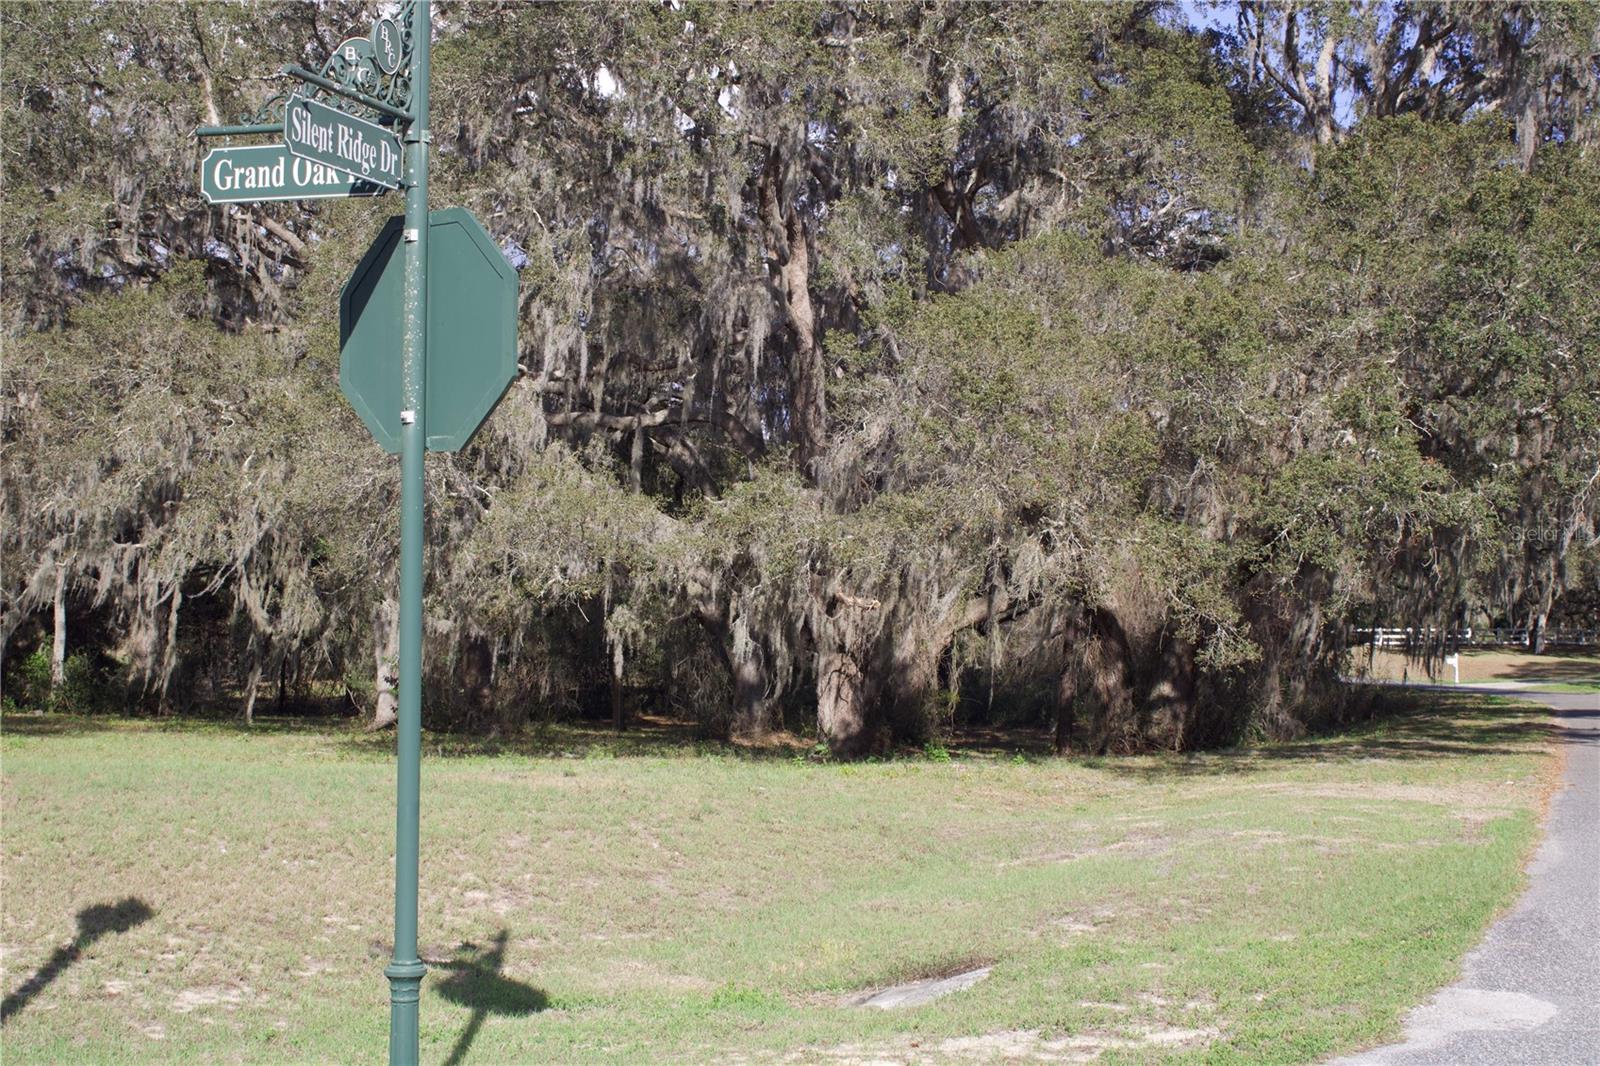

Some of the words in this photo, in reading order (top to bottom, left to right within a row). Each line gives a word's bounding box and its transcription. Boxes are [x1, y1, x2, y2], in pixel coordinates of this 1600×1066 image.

[291, 107, 334, 154] Silent
[337, 123, 377, 175] Ridge
[380, 140, 398, 175] Dr
[214, 157, 284, 191] Grand
